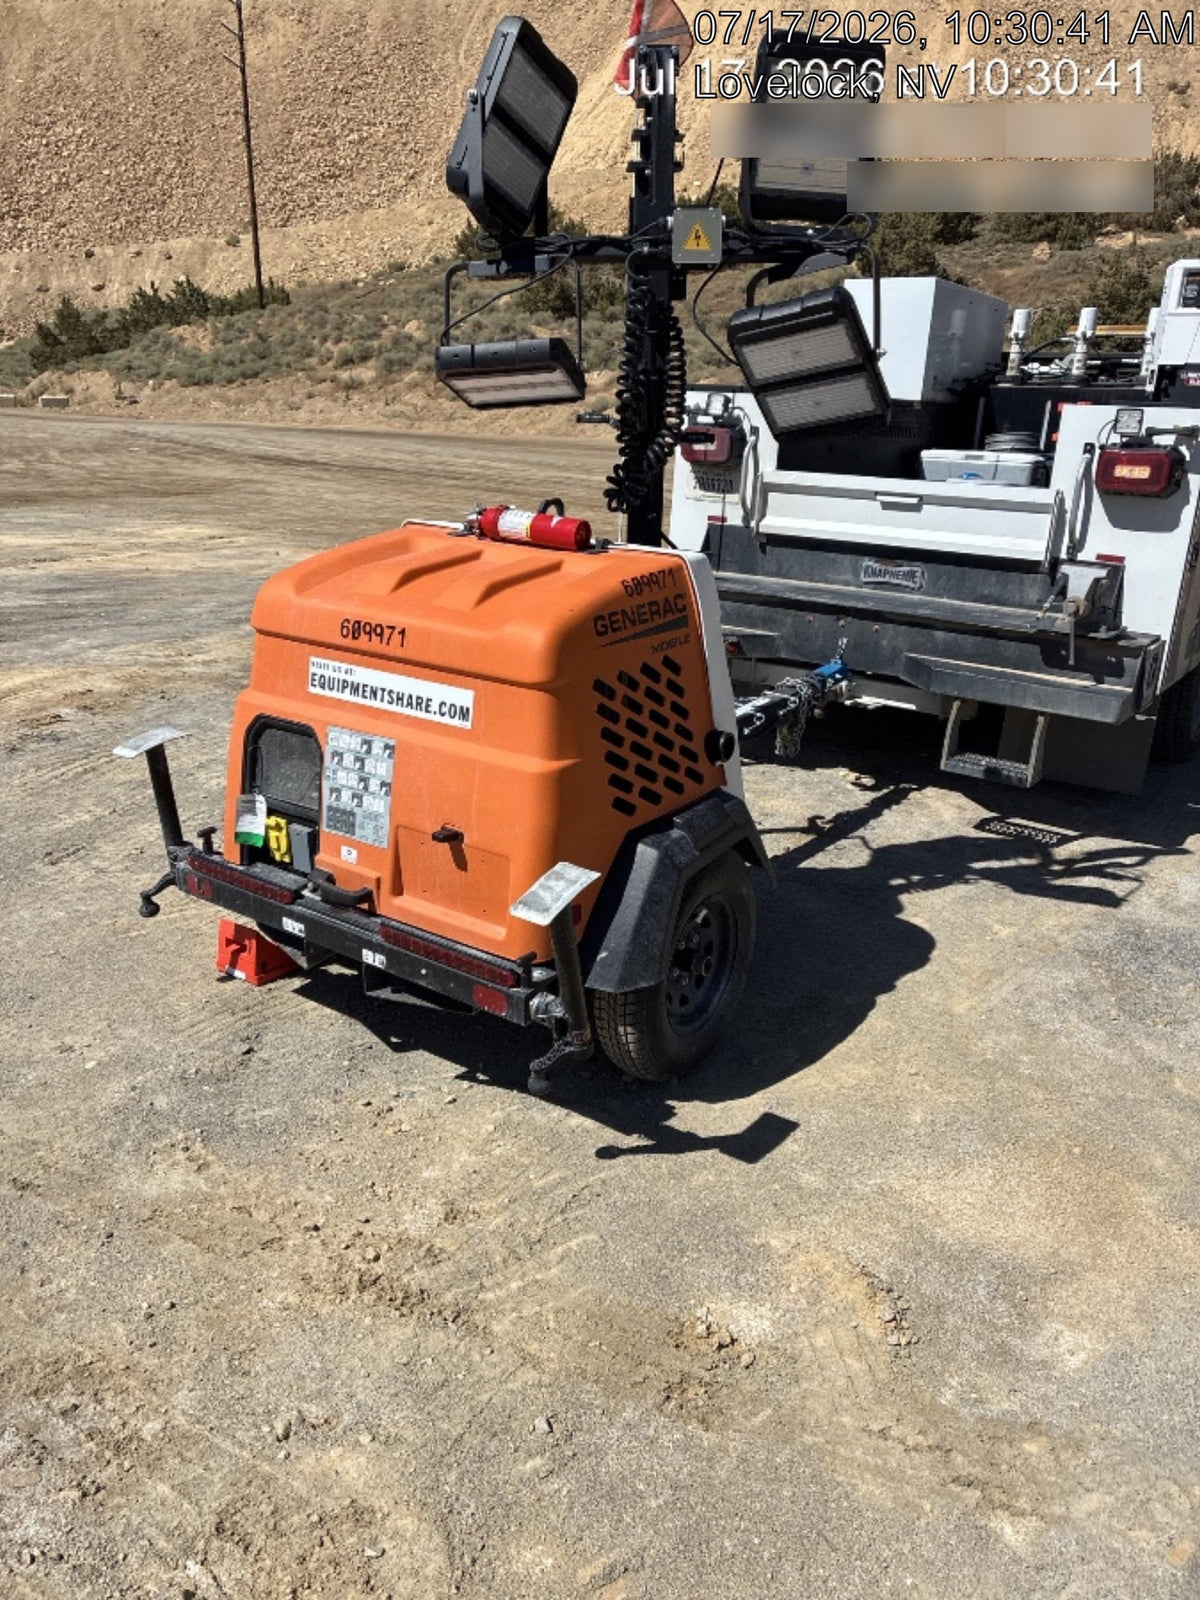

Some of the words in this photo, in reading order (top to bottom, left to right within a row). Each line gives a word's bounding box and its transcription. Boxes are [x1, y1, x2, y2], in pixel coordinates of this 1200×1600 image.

[621, 568, 677, 598] 609971
[340, 618, 407, 648] 609971
[593, 593, 687, 637] GENERAC
[310, 672, 470, 722] EQUIPMENTSHARE.COM
